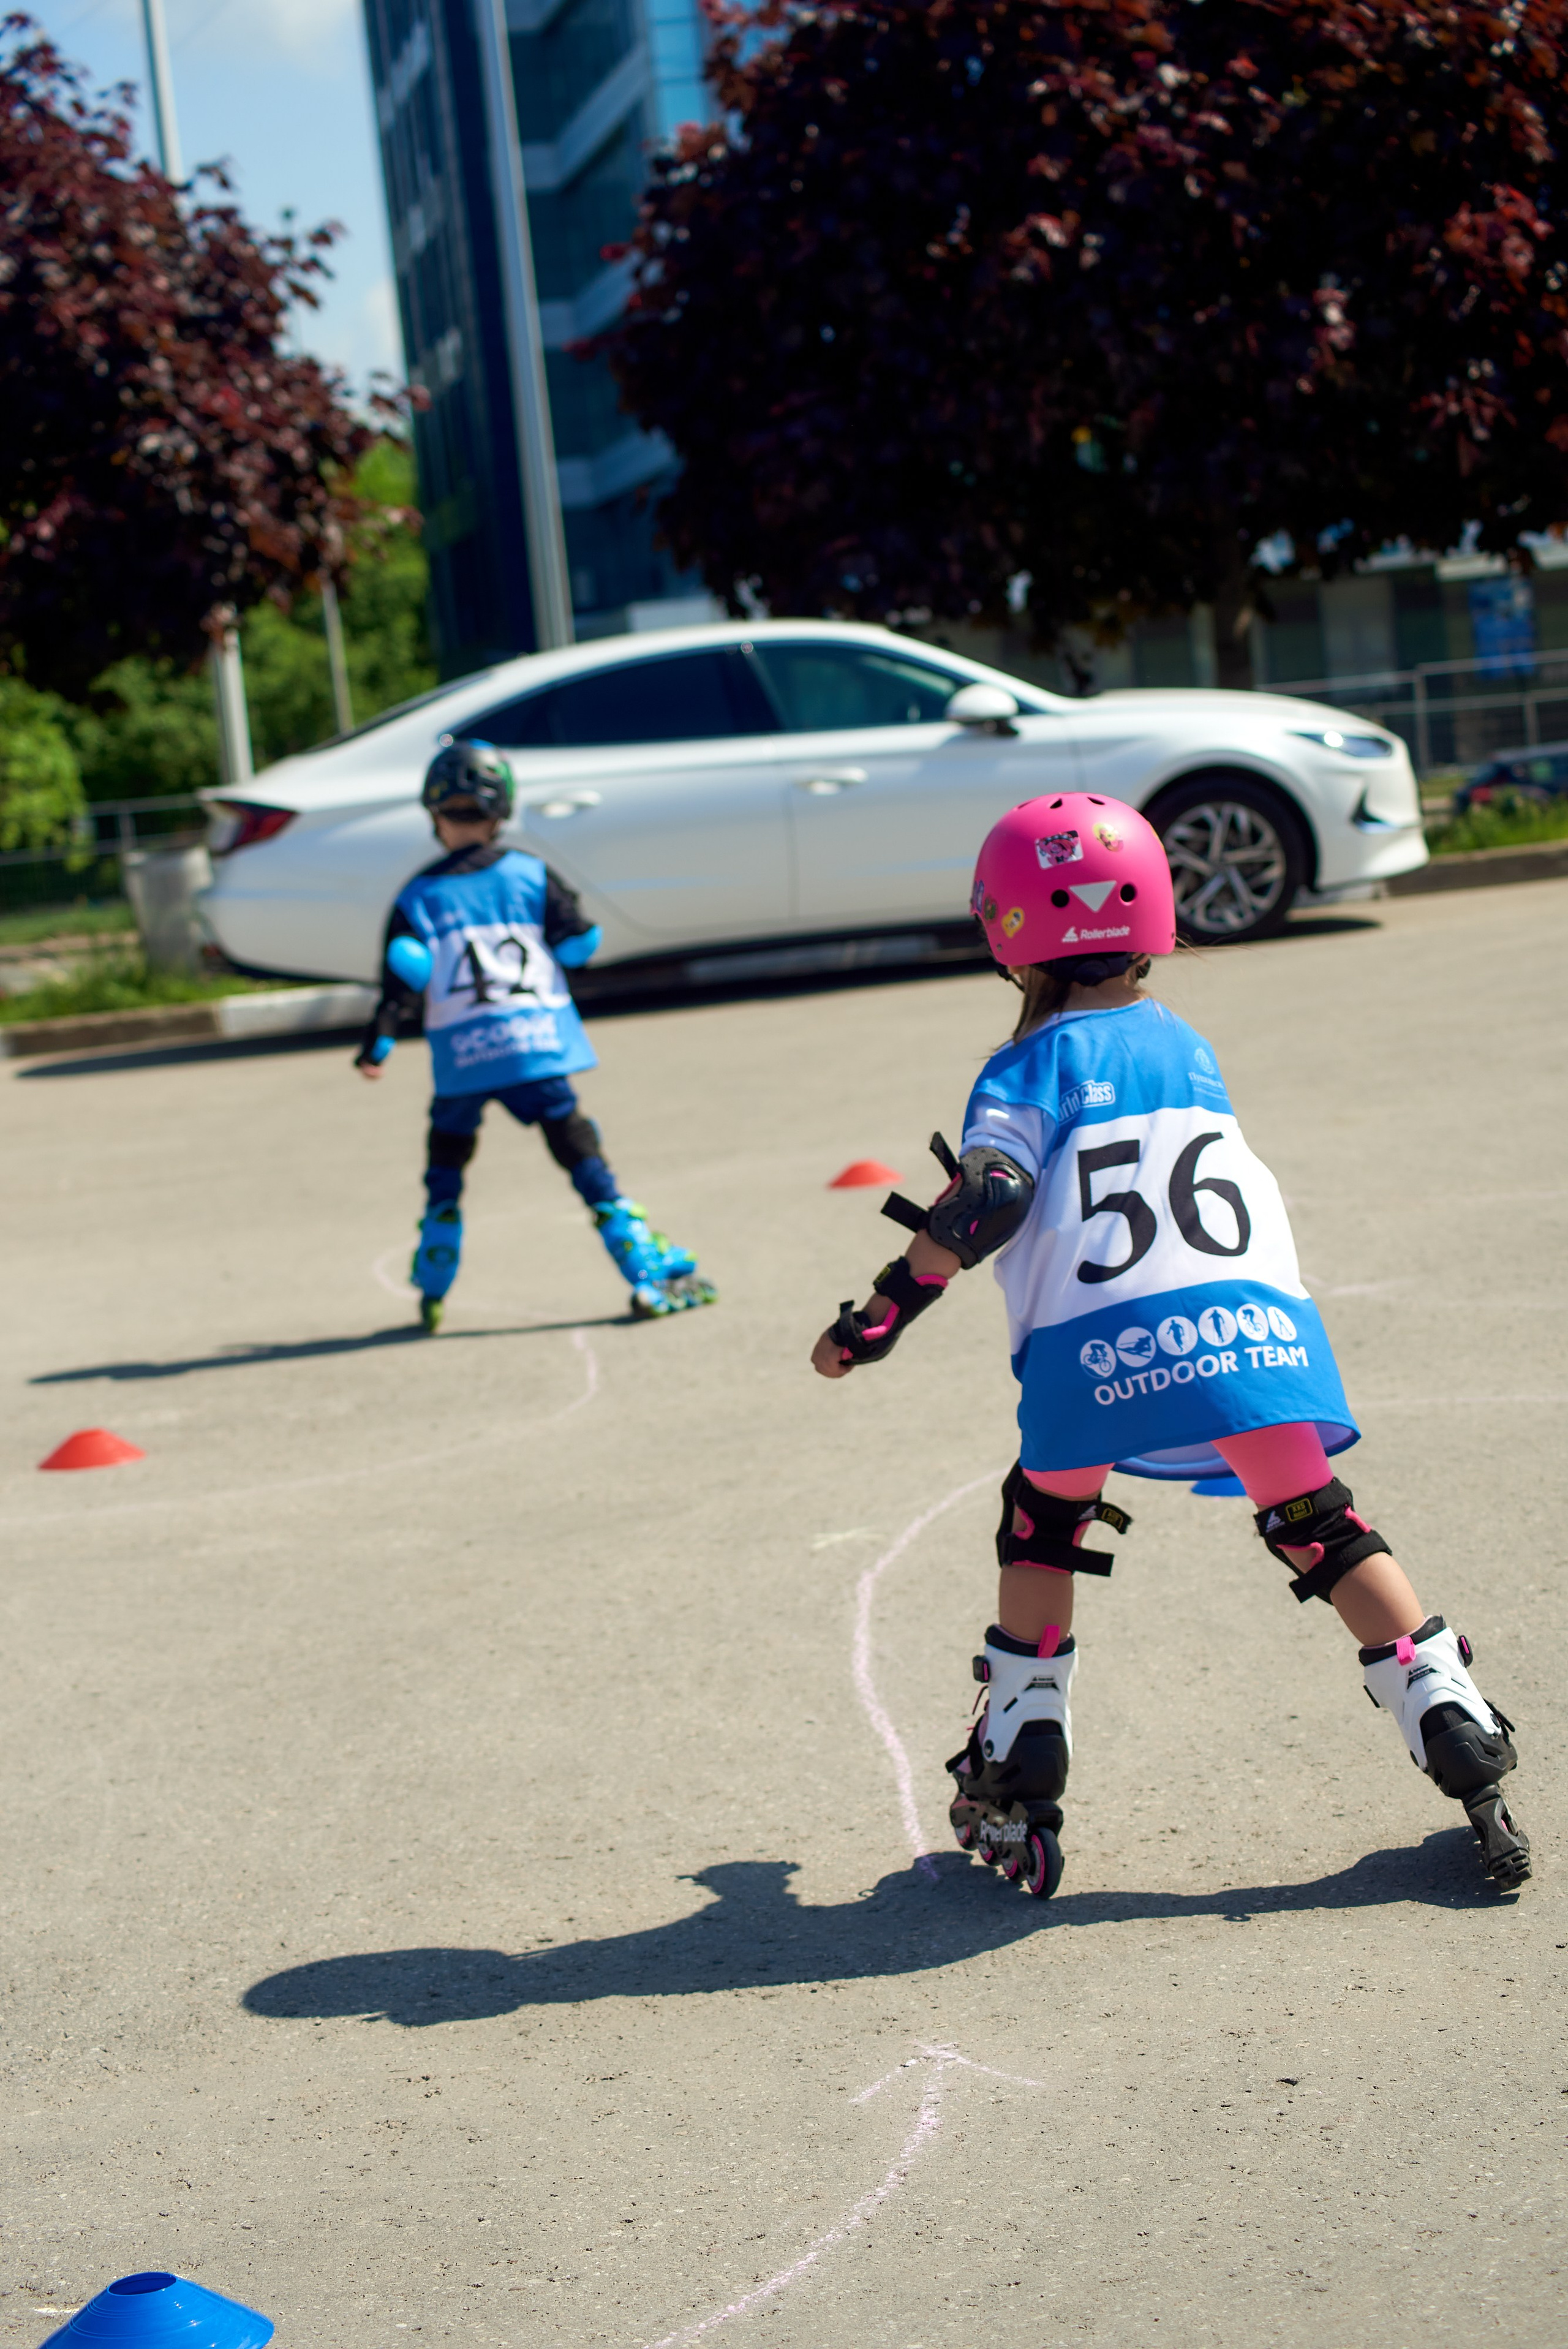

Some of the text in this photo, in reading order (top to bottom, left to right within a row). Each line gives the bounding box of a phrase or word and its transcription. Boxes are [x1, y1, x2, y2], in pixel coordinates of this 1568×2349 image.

[1080, 926, 1130, 940] Rollerblade
[448, 936, 540, 1006] 42
[1059, 1084, 1112, 1122] rld Class
[1077, 1131, 1251, 1283] 56
[1095, 1346, 1309, 1405] OUTDOOR TEAM
